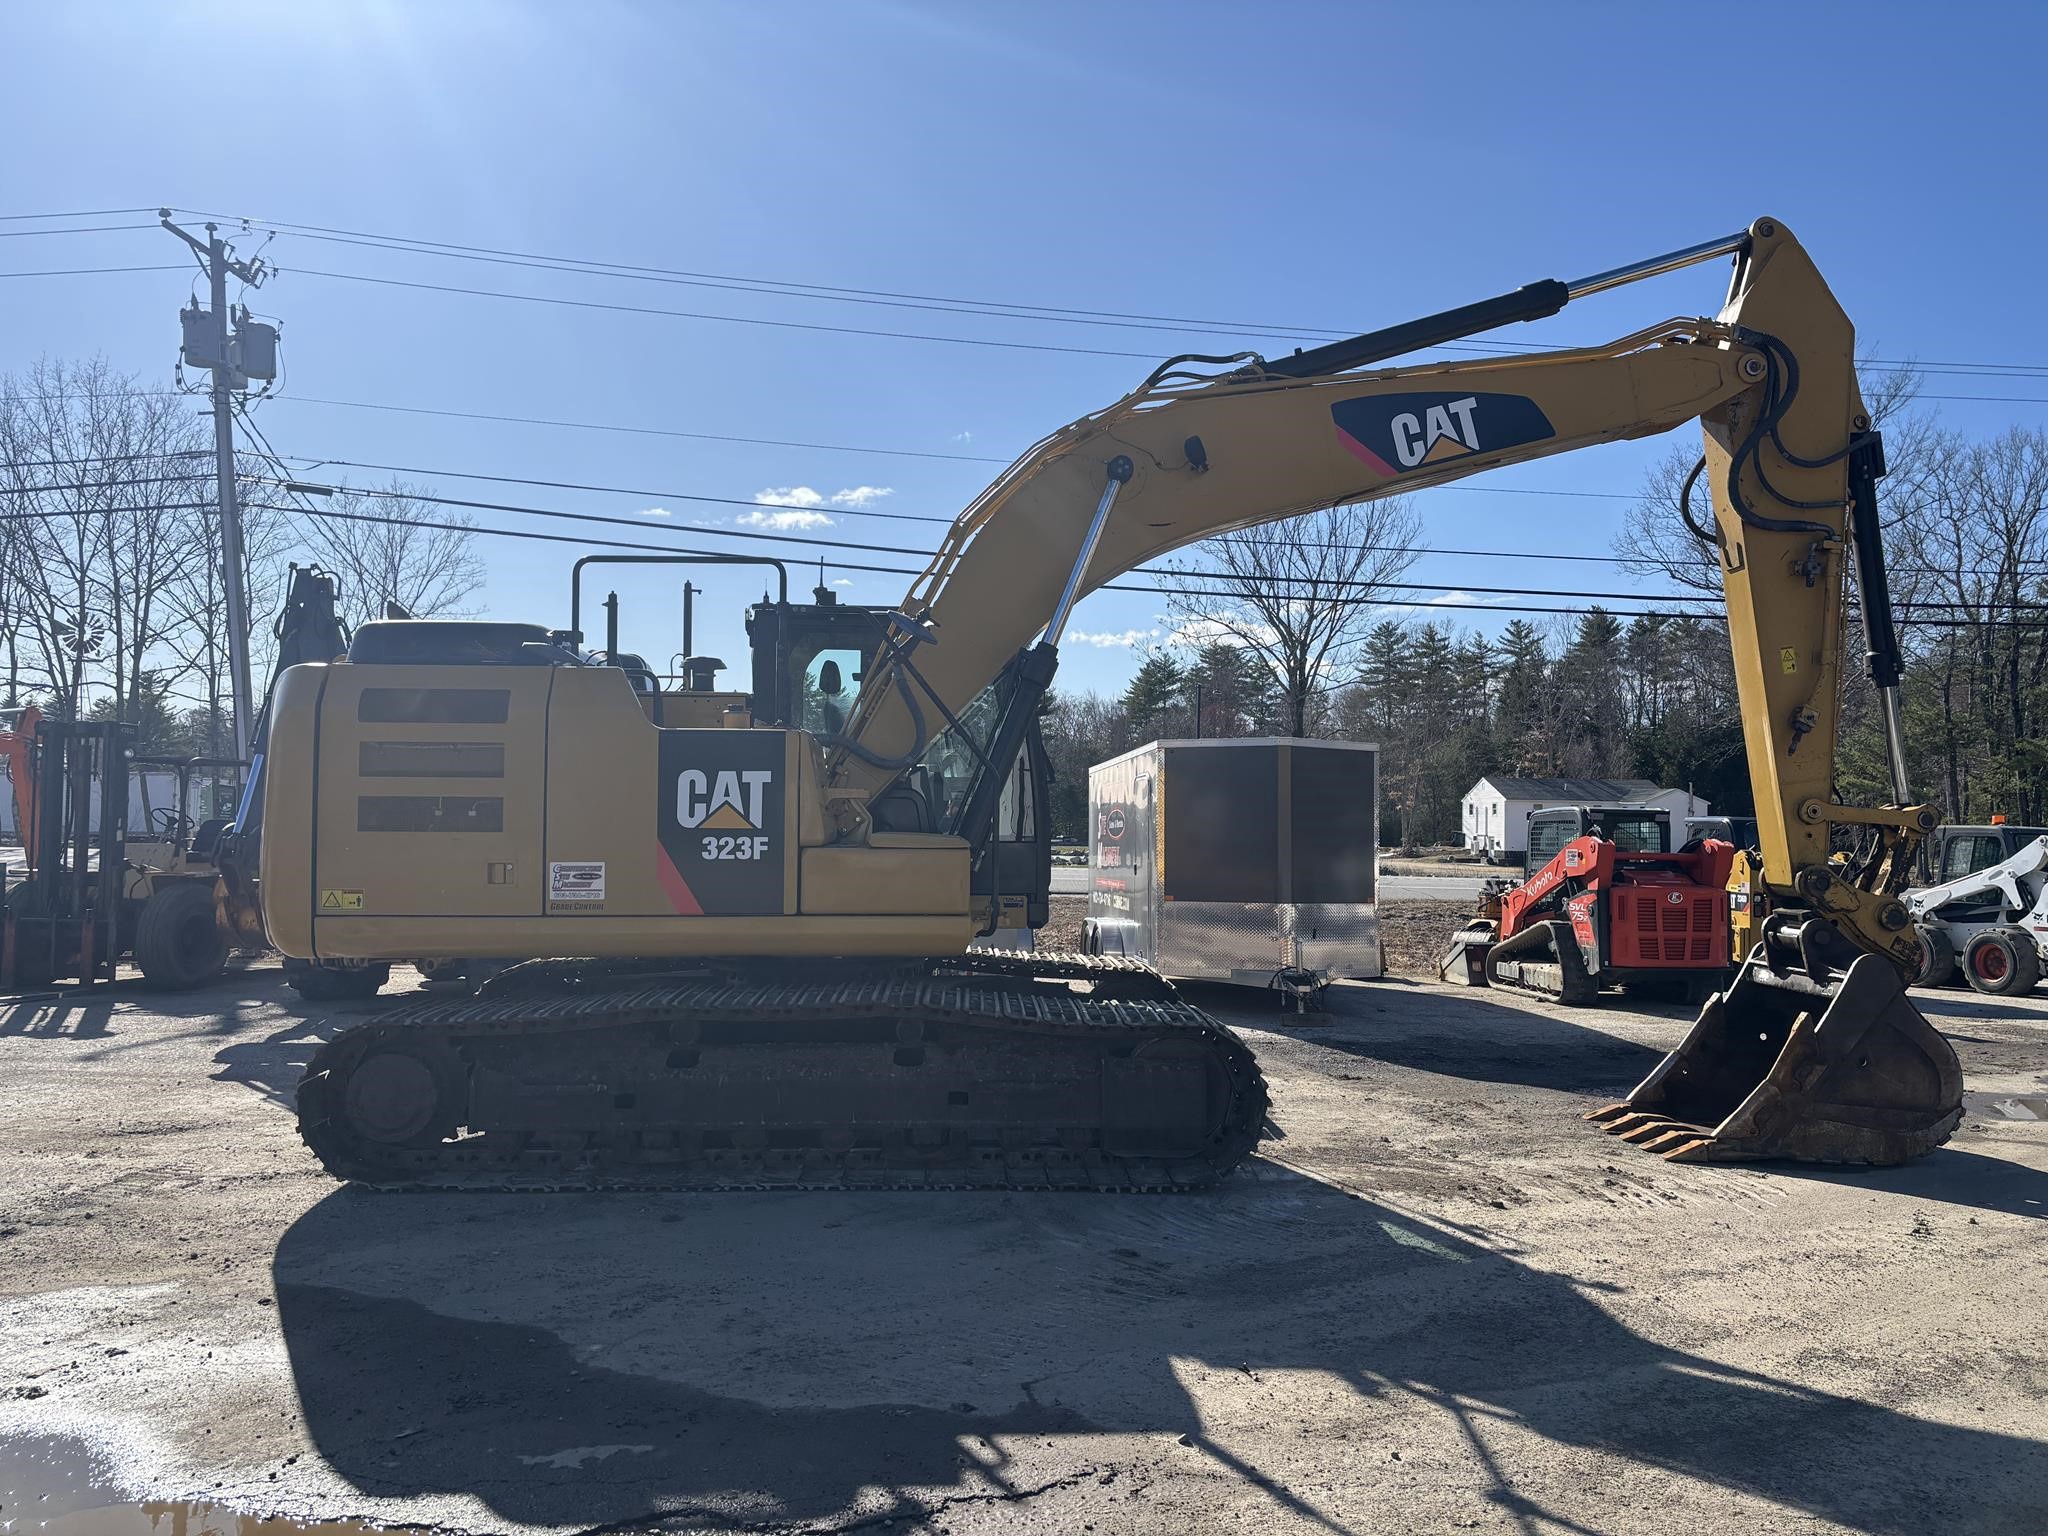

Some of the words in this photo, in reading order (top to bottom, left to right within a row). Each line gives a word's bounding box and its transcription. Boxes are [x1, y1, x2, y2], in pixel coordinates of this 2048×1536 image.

[1391, 397, 1480, 467] CAT
[677, 769, 772, 829] CAT
[702, 836, 769, 860] 323F
[1526, 871, 1553, 896] Kubota
[1568, 903, 1587, 911] SVL
